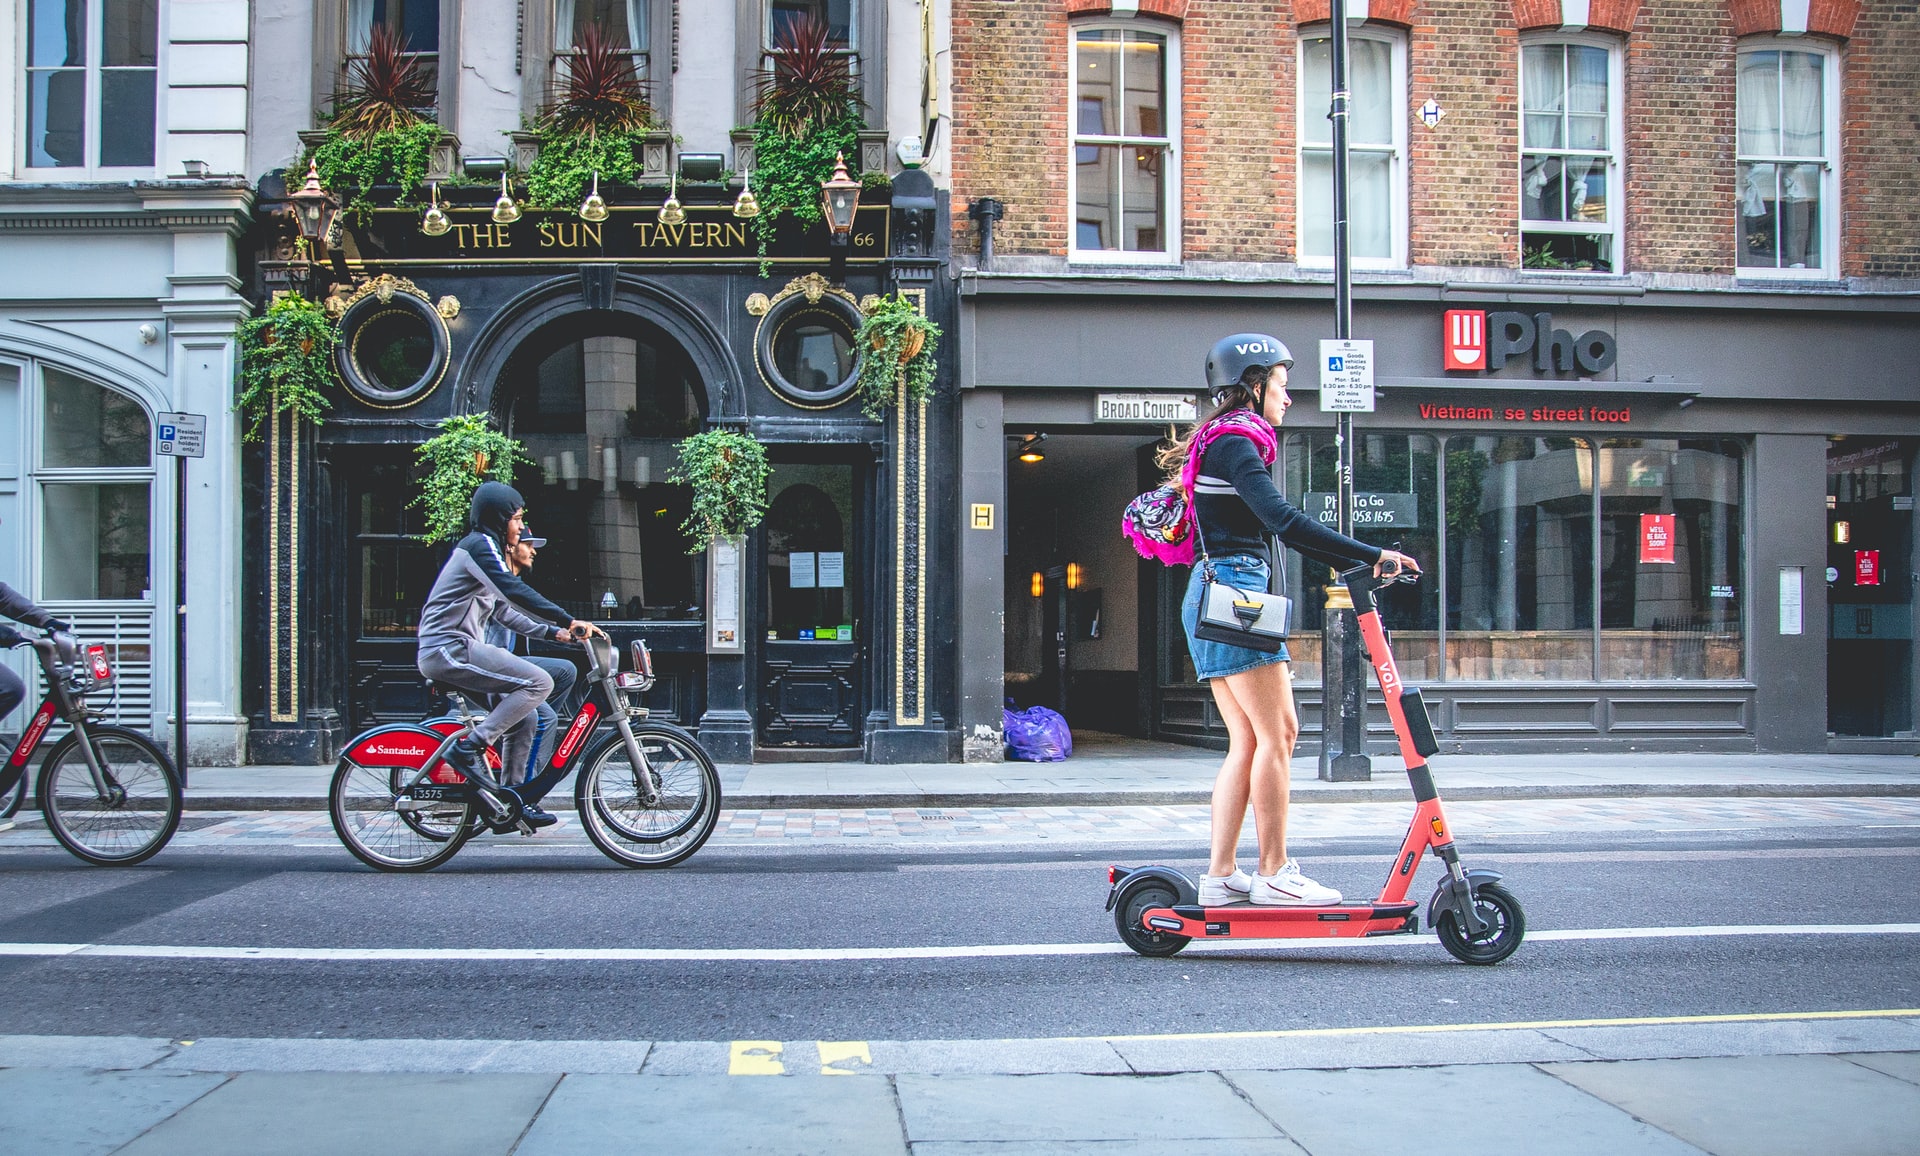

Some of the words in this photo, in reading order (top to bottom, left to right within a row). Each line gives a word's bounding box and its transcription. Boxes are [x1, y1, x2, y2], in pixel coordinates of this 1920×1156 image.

[1424, 105, 1438, 122] H
[452, 224, 511, 248] THE
[540, 223, 603, 248] SUN
[633, 223, 746, 248] TAVERN
[854, 232, 875, 247] 66
[1235, 339, 1276, 355] voi.
[1487, 311, 1617, 373] Pho
[1102, 401, 1140, 418] BROAD
[1143, 401, 1181, 418] COURT
[1420, 404, 1493, 419] Vietnam
[1532, 406, 1585, 421] street
[1590, 406, 1630, 422] food
[163, 427, 174, 439] P
[1353, 495, 1367, 508] To
[1369, 494, 1384, 507] Go
[975, 507, 990, 526] H
[1379, 661, 1399, 694] voi.
[377, 745, 426, 756] Santander
